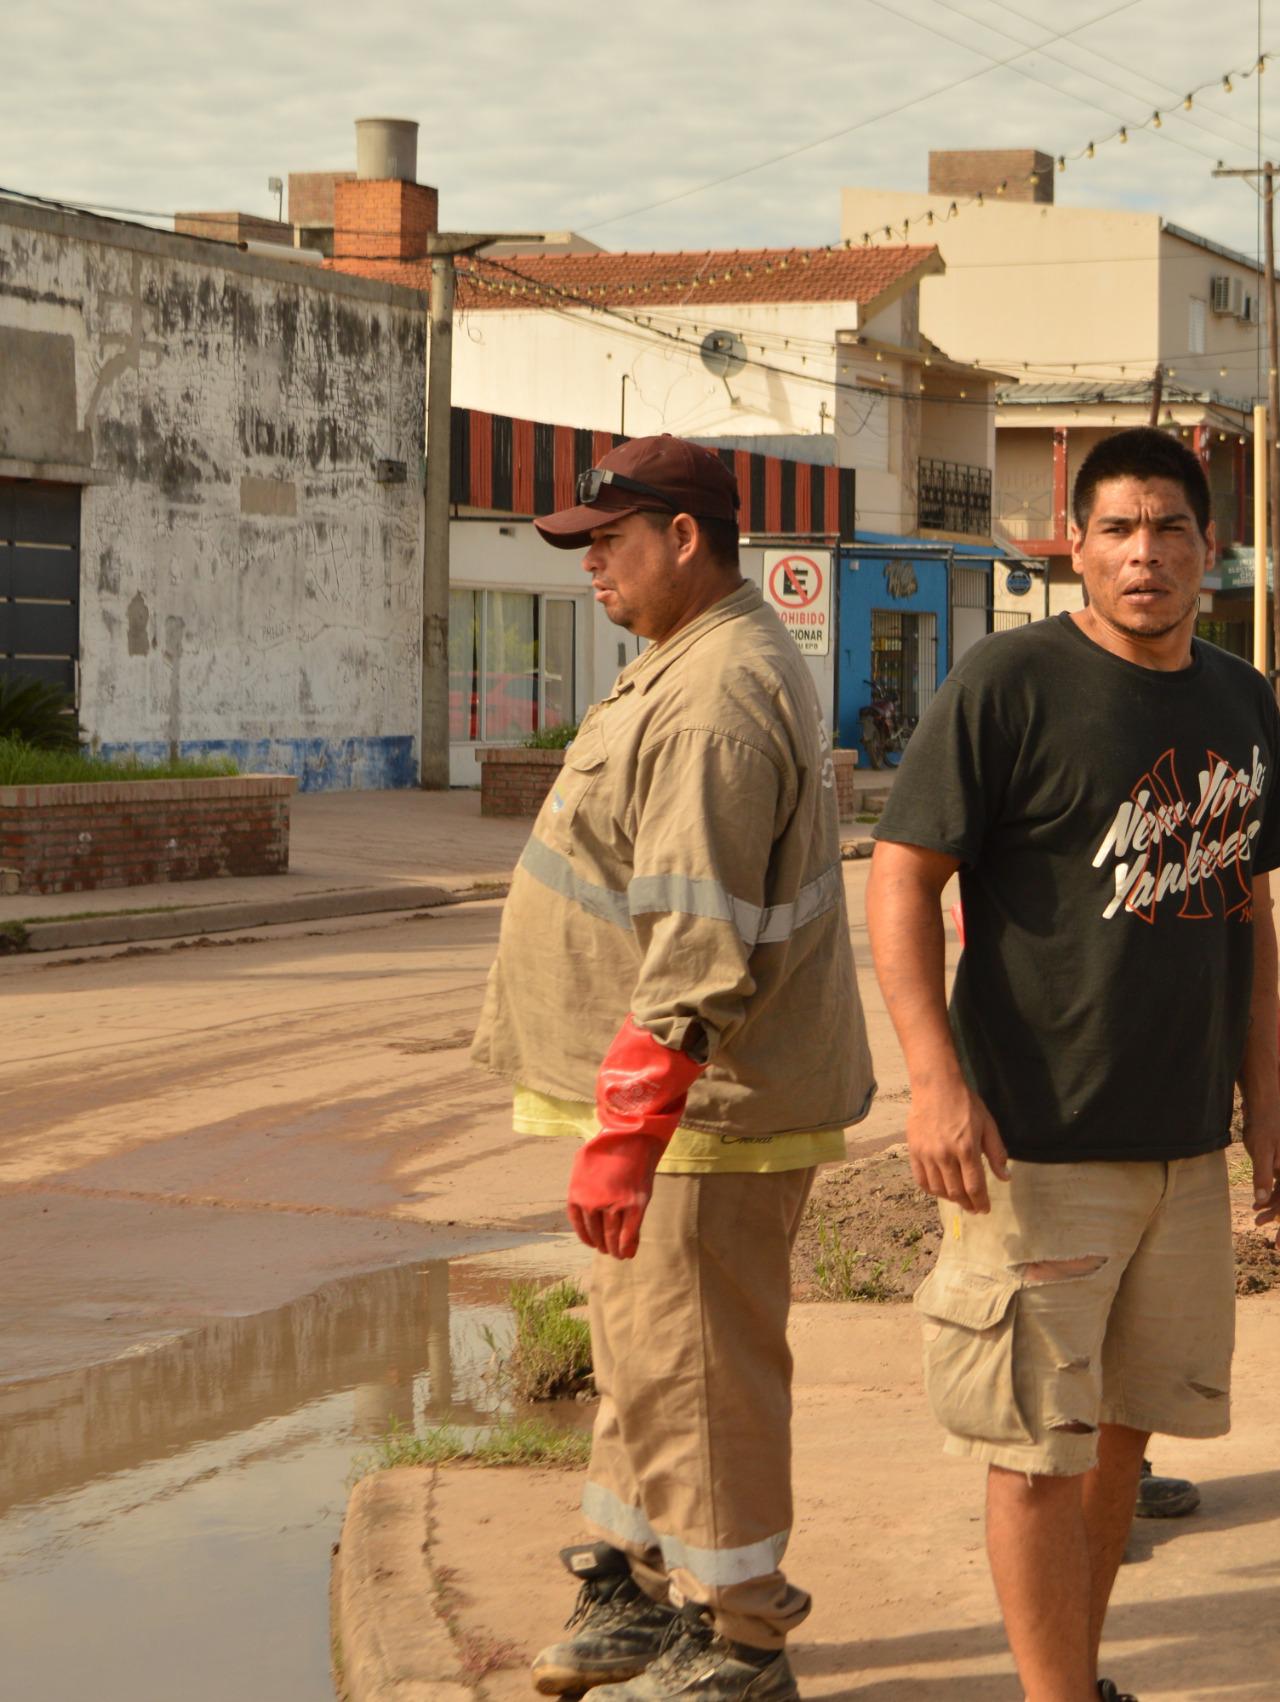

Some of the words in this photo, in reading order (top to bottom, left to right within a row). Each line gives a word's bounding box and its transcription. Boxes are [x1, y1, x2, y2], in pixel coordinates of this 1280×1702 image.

[777, 612, 825, 625] OHIBIDO
[1092, 789, 1191, 868] New
[1192, 745, 1266, 826] York
[1102, 819, 1261, 920] Yankees
